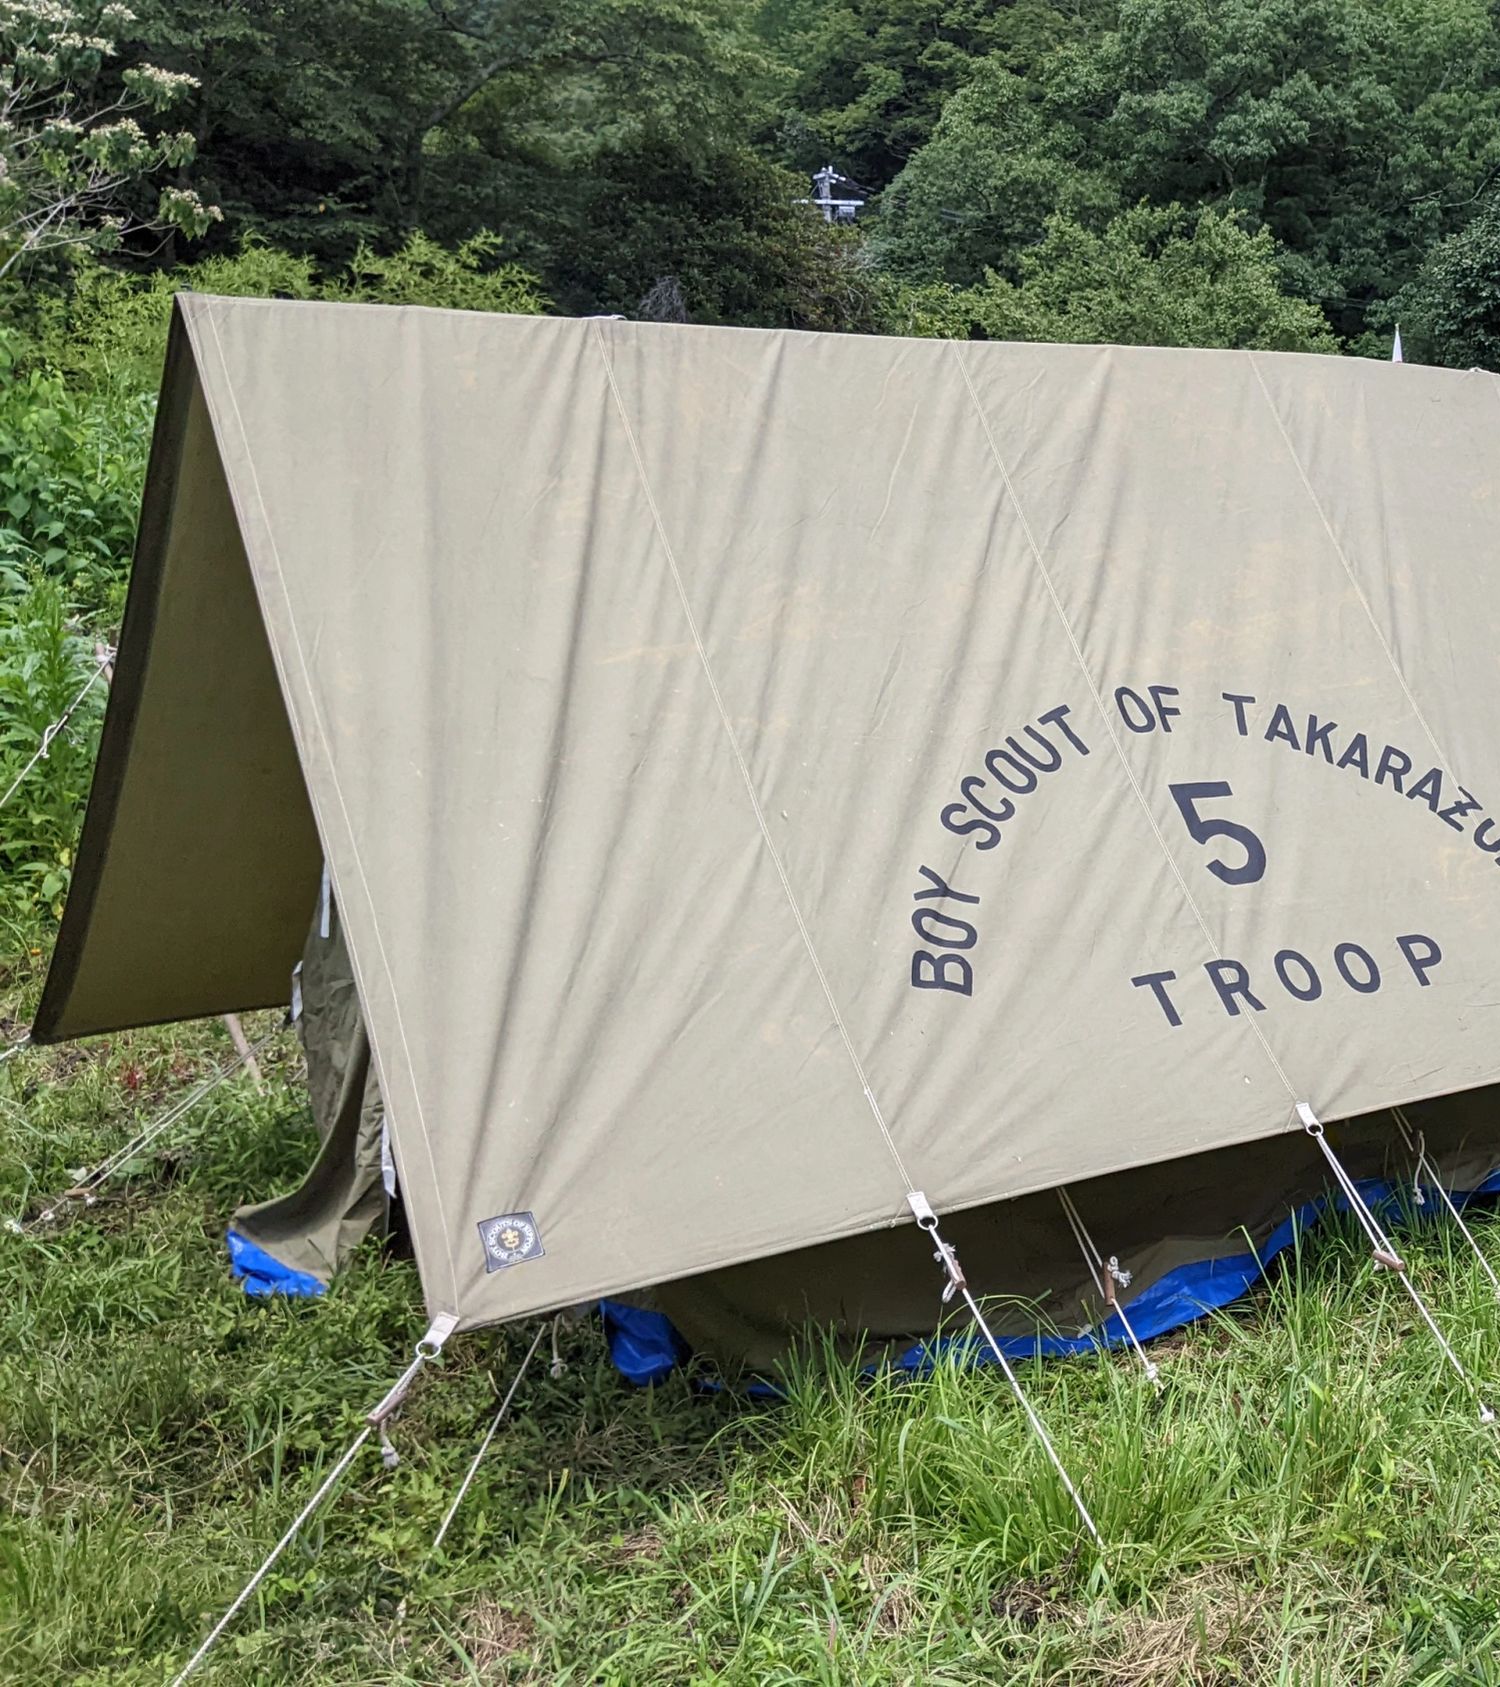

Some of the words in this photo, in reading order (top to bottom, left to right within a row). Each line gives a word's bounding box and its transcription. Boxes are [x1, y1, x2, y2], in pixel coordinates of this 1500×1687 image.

[1114, 685, 1181, 734] OF
[940, 704, 1090, 851] SCOUT
[1168, 781, 1267, 886] 5
[911, 865, 980, 997] BOY
[1130, 934, 1443, 1027] TROOP
